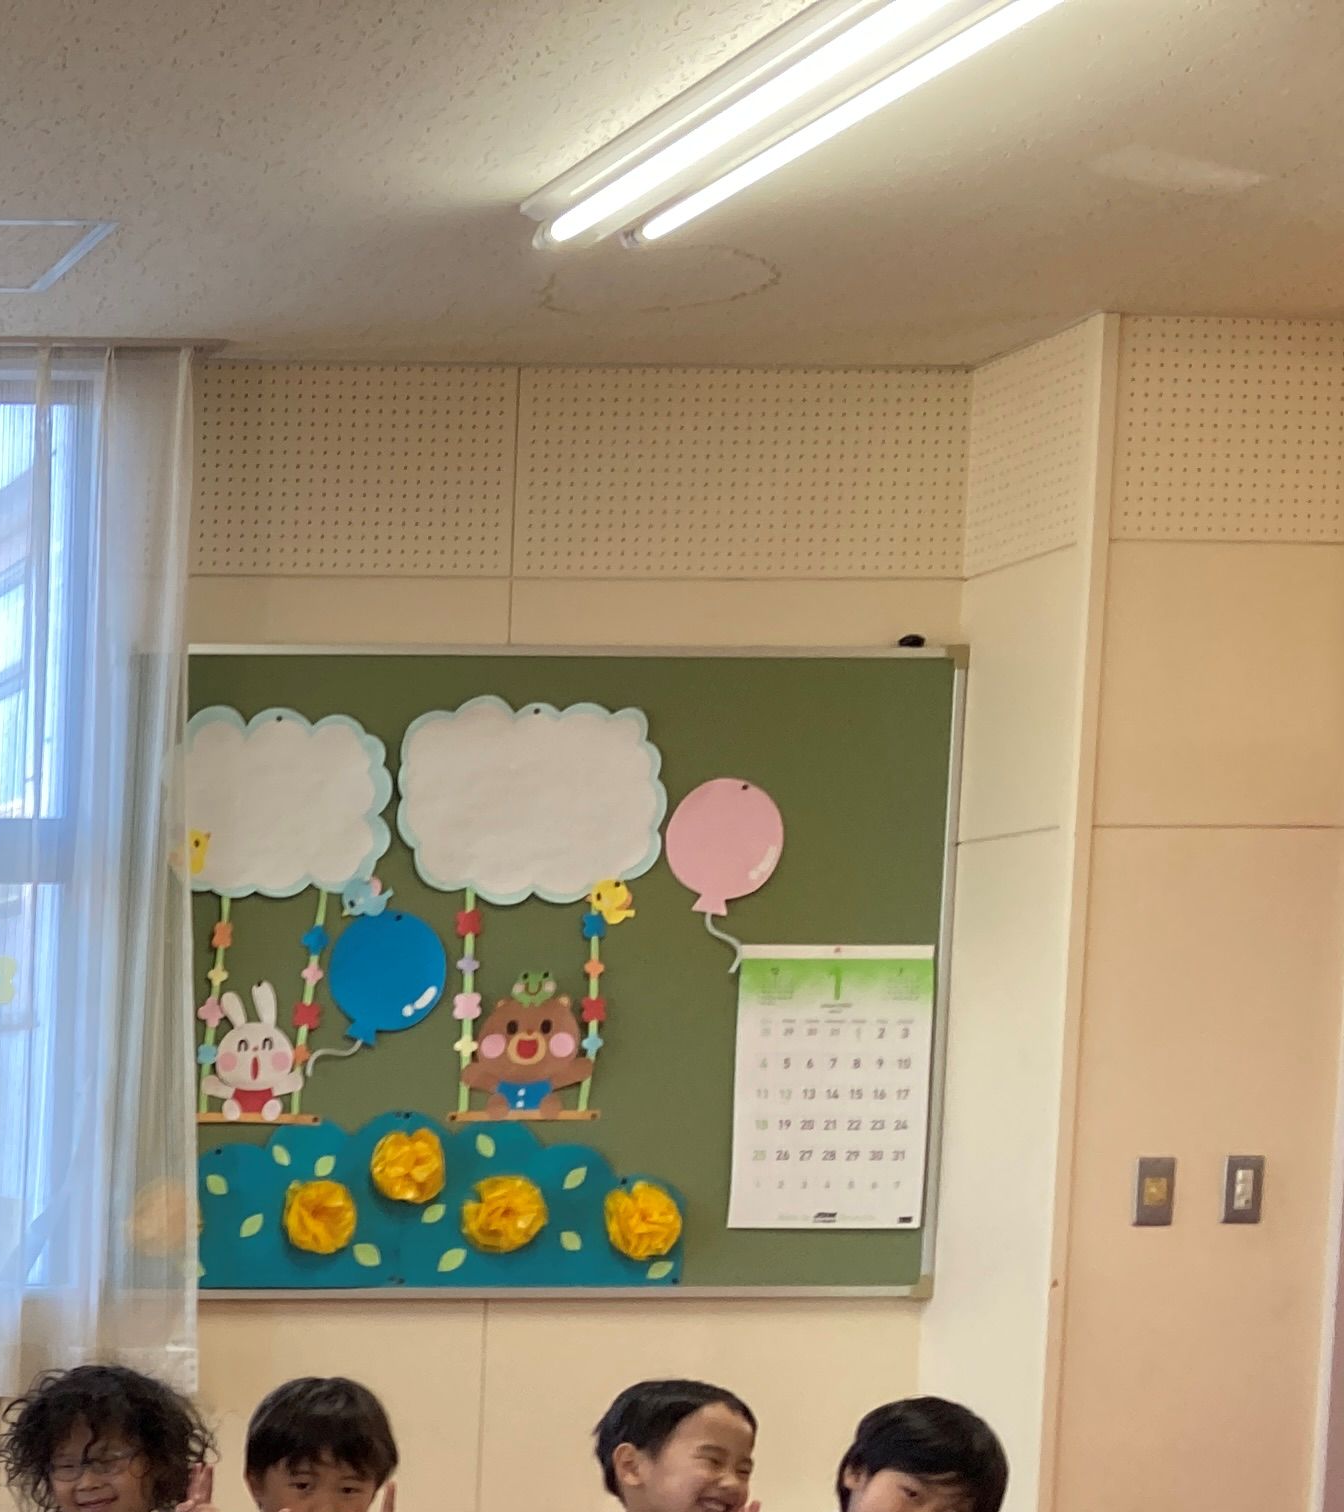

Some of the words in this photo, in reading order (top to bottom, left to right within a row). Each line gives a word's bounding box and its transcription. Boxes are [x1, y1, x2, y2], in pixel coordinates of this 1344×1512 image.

[783, 1058, 791, 1069] 5
[806, 1058, 814, 1069] 6
[830, 1058, 838, 1069] 7
[853, 1058, 861, 1069] 8
[876, 1058, 884, 1069] 9
[802, 1088, 816, 1099] 13
[825, 1089, 839, 1099] 14
[850, 1088, 863, 1100] 15
[873, 1088, 886, 1100] 16
[896, 1089, 910, 1099] 17
[778, 1119, 791, 1130] 19
[800, 1119, 814, 1130] 20
[824, 1119, 837, 1130] 21
[847, 1119, 861, 1130] 22
[870, 1119, 885, 1130] 23
[894, 1119, 908, 1130] 24
[776, 1150, 790, 1161] 26
[799, 1150, 812, 1161] 27
[822, 1150, 836, 1161] 28
[845, 1150, 860, 1161] 29
[868, 1150, 883, 1161] 30
[892, 1150, 905, 1161] 31
